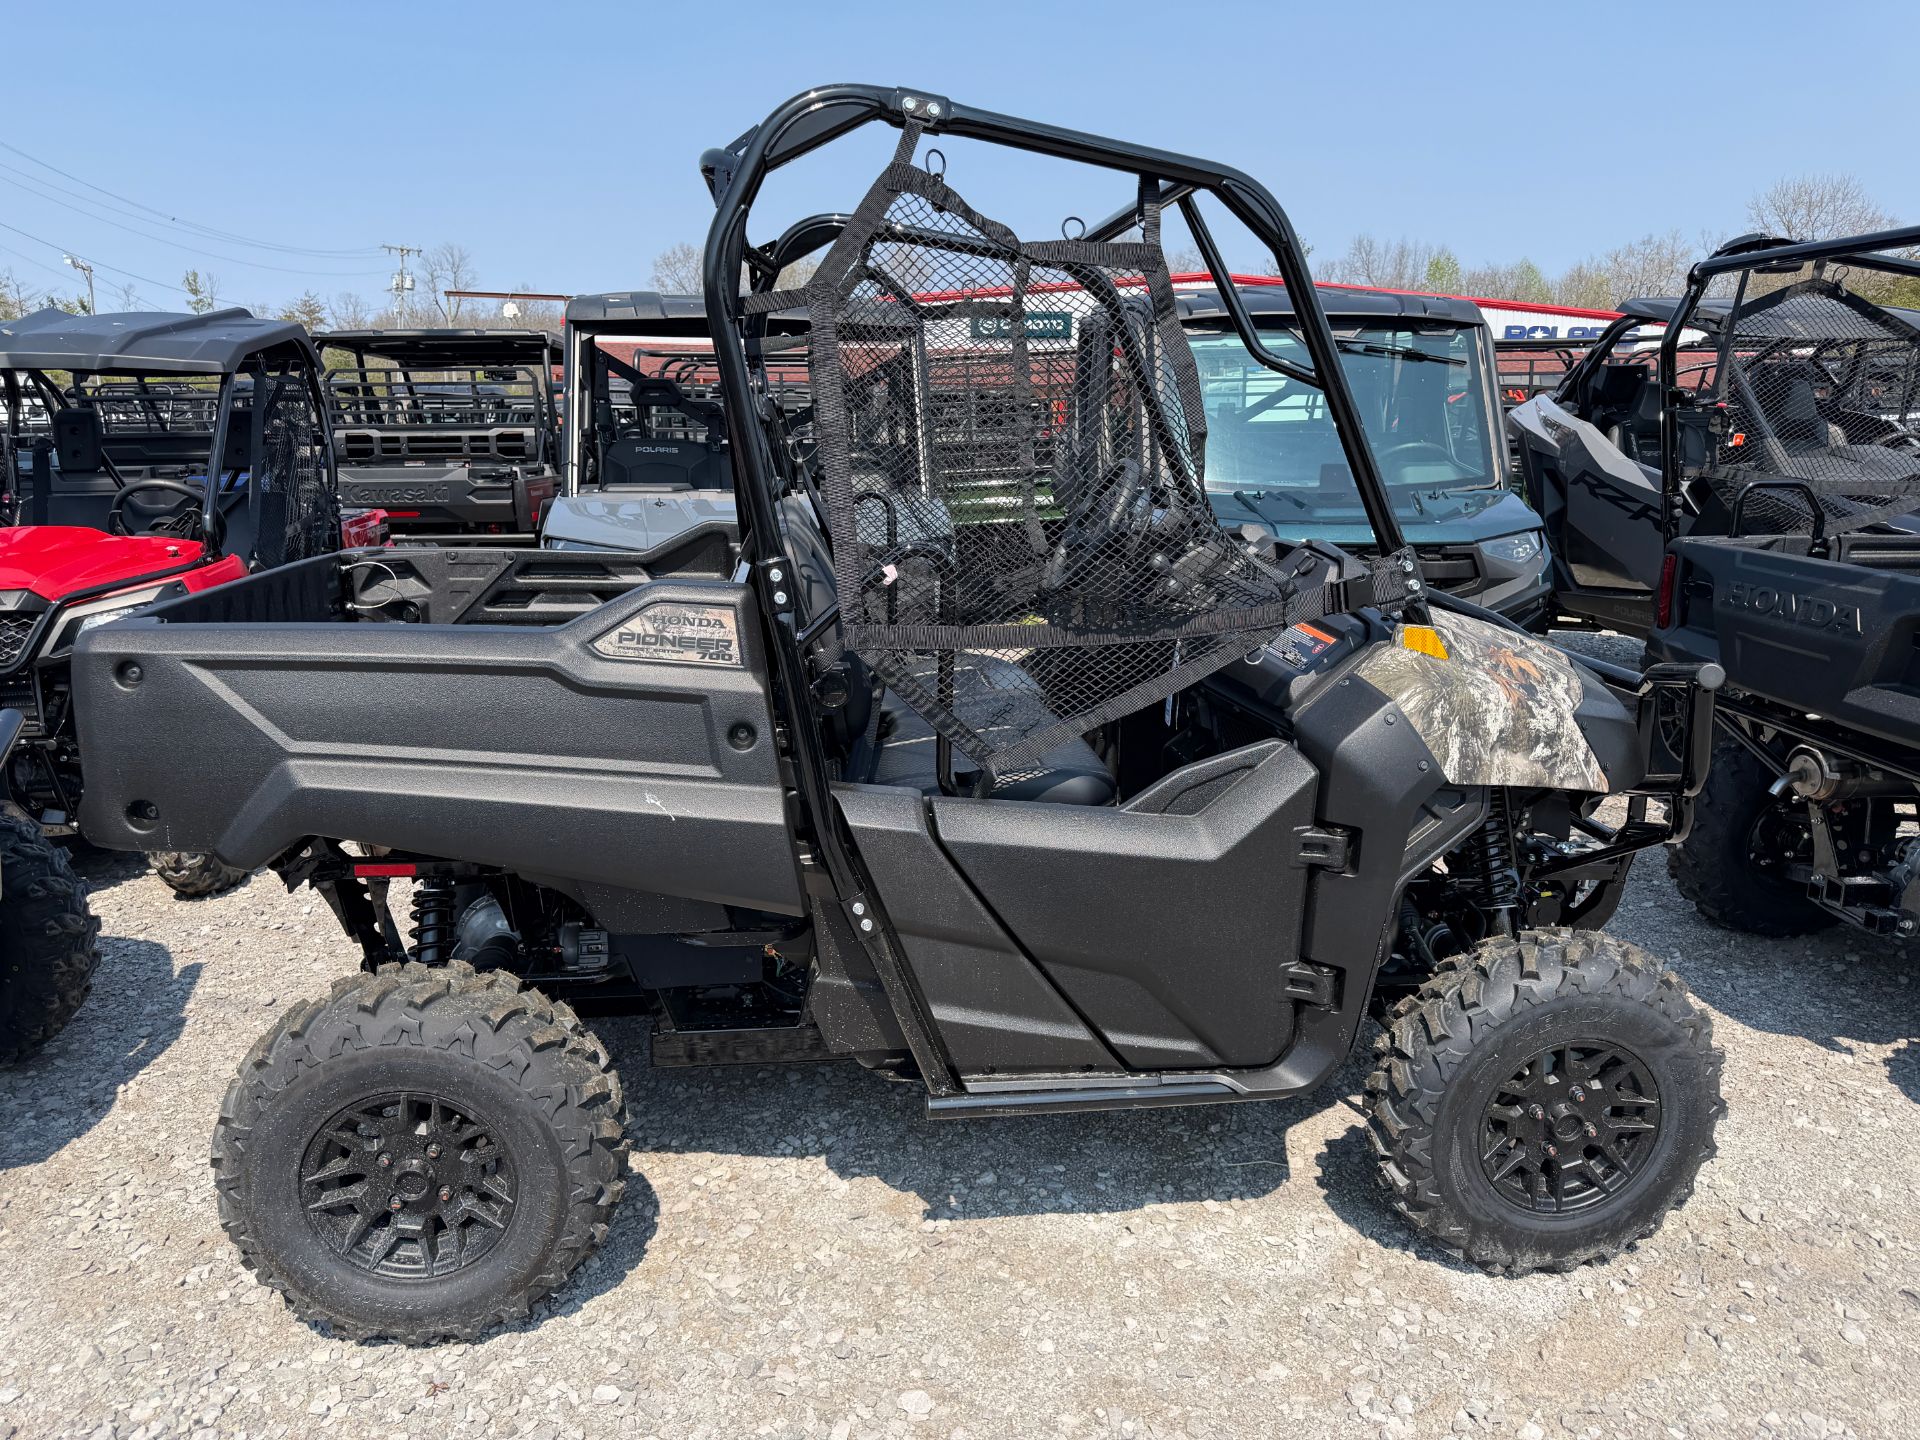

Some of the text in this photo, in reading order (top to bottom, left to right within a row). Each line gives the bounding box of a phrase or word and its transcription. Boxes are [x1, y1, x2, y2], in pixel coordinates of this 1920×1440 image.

[635, 446, 679, 454] POLARIS
[343, 484, 449, 503] Kawasaki
[1613, 603, 1655, 622] POLARIS
[1721, 580, 1865, 637] HONDA
[651, 614, 726, 629] HONDA
[618, 631, 732, 651] PIONEER
[696, 651, 733, 661] 700
[1512, 1006, 1622, 1047] KENDA
